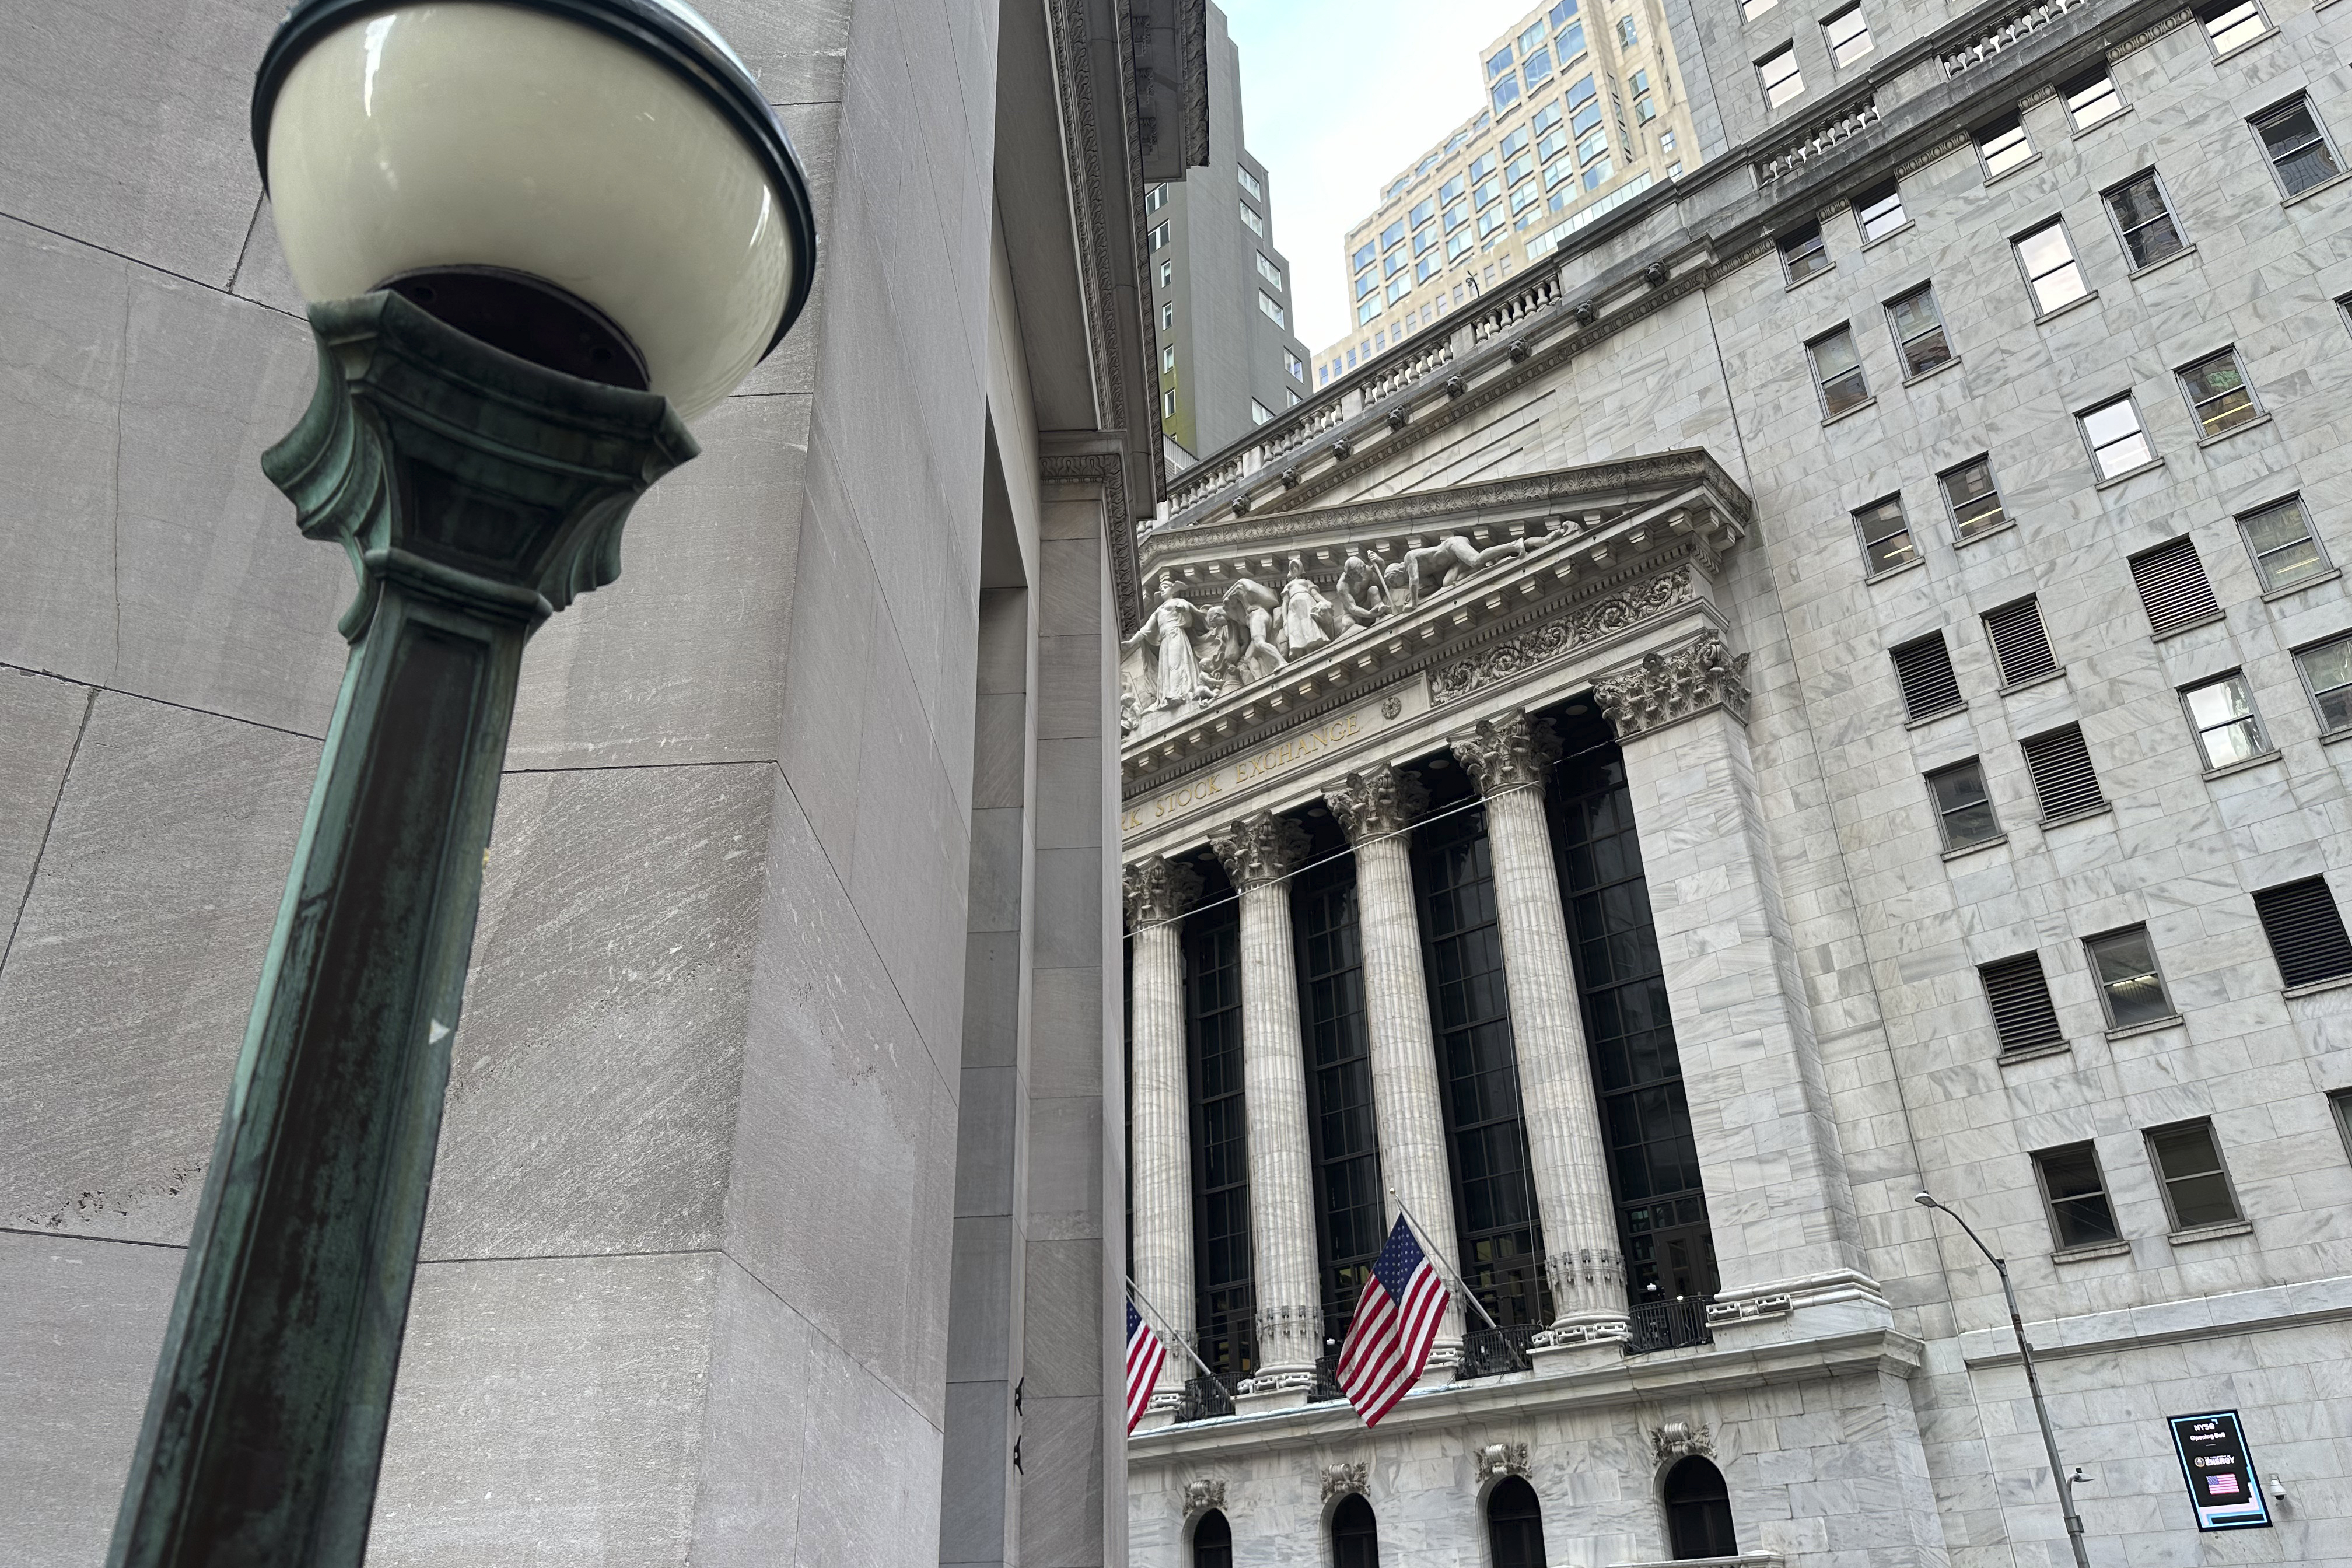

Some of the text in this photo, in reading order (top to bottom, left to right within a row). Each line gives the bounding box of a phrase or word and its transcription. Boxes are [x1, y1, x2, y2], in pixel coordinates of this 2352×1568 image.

[1155, 774, 1222, 817] STOCK
[1236, 713, 1360, 784] EXCHANGE
[2205, 1456, 2235, 1466] ENERGY
